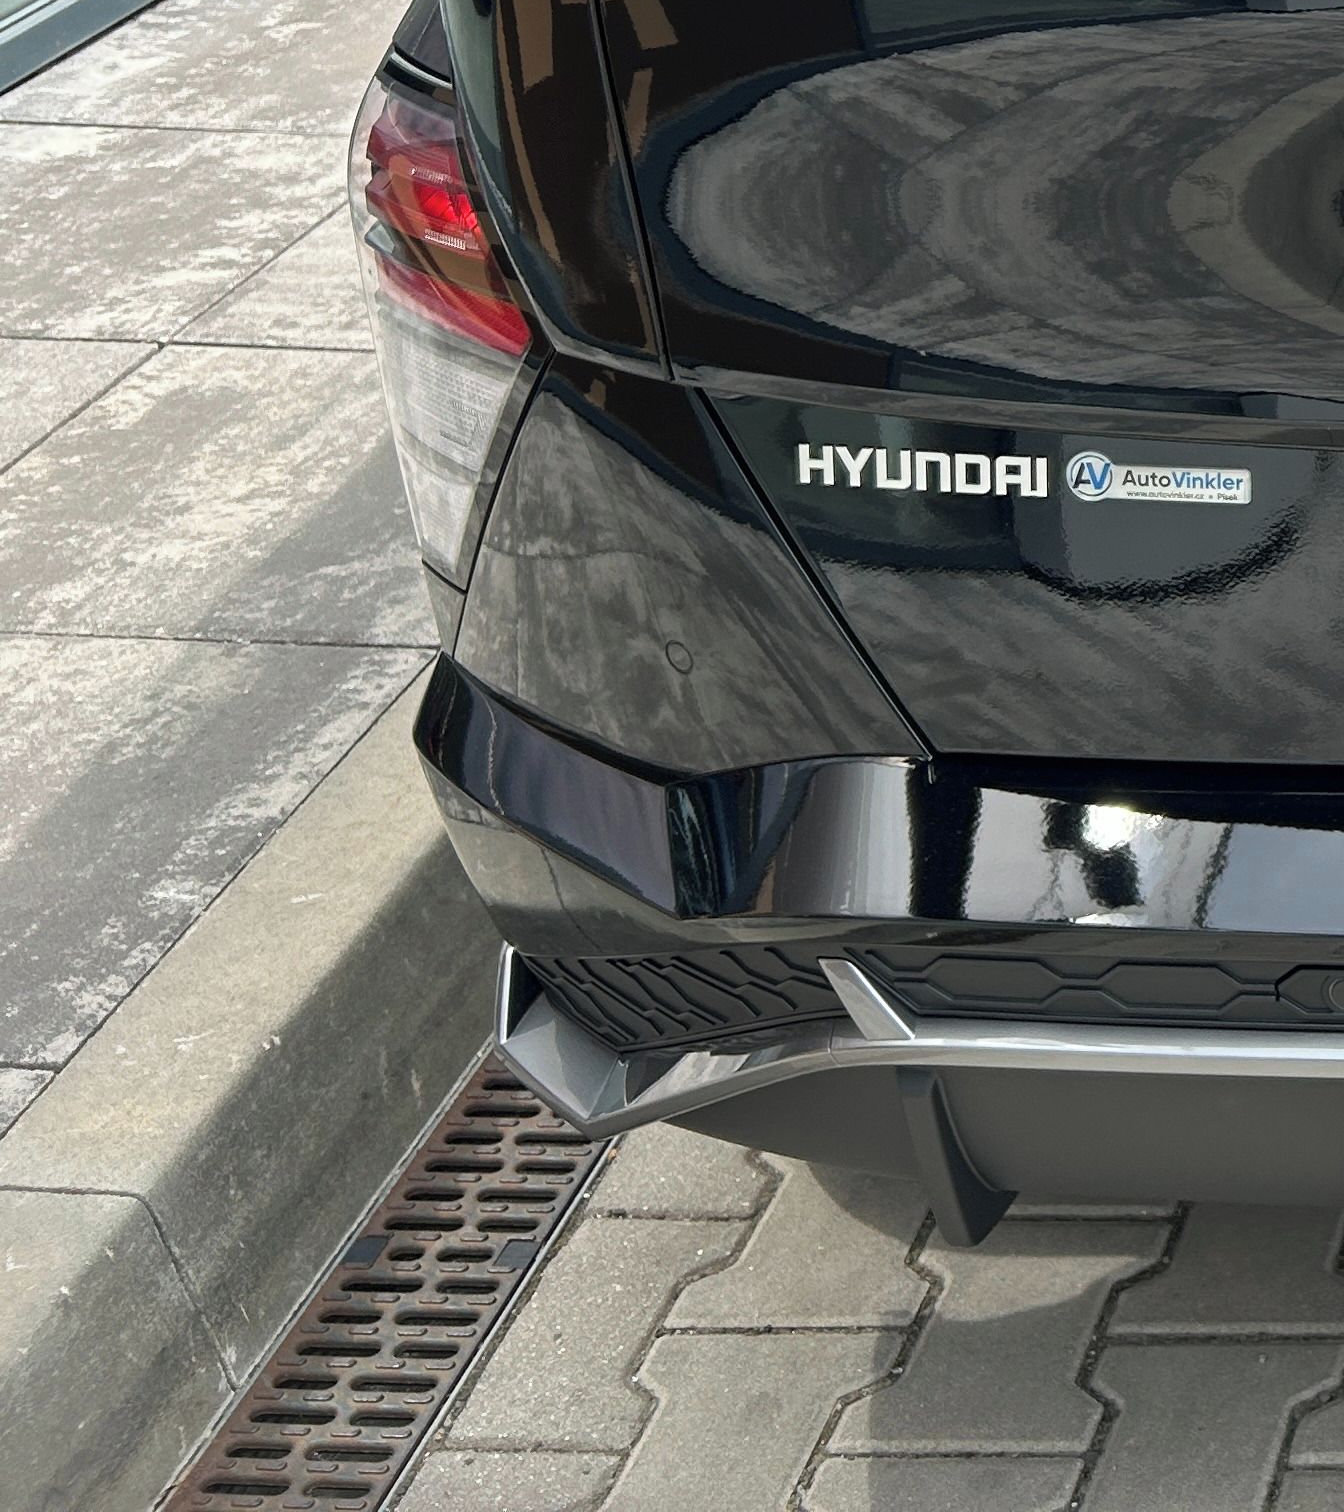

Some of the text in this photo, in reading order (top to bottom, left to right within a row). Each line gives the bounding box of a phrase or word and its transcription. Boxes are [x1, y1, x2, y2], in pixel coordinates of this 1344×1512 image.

[798, 442, 1048, 499] HYUNDAI
[1072, 462, 1111, 490] AV
[1121, 469, 1244, 491] AutoVinkler
